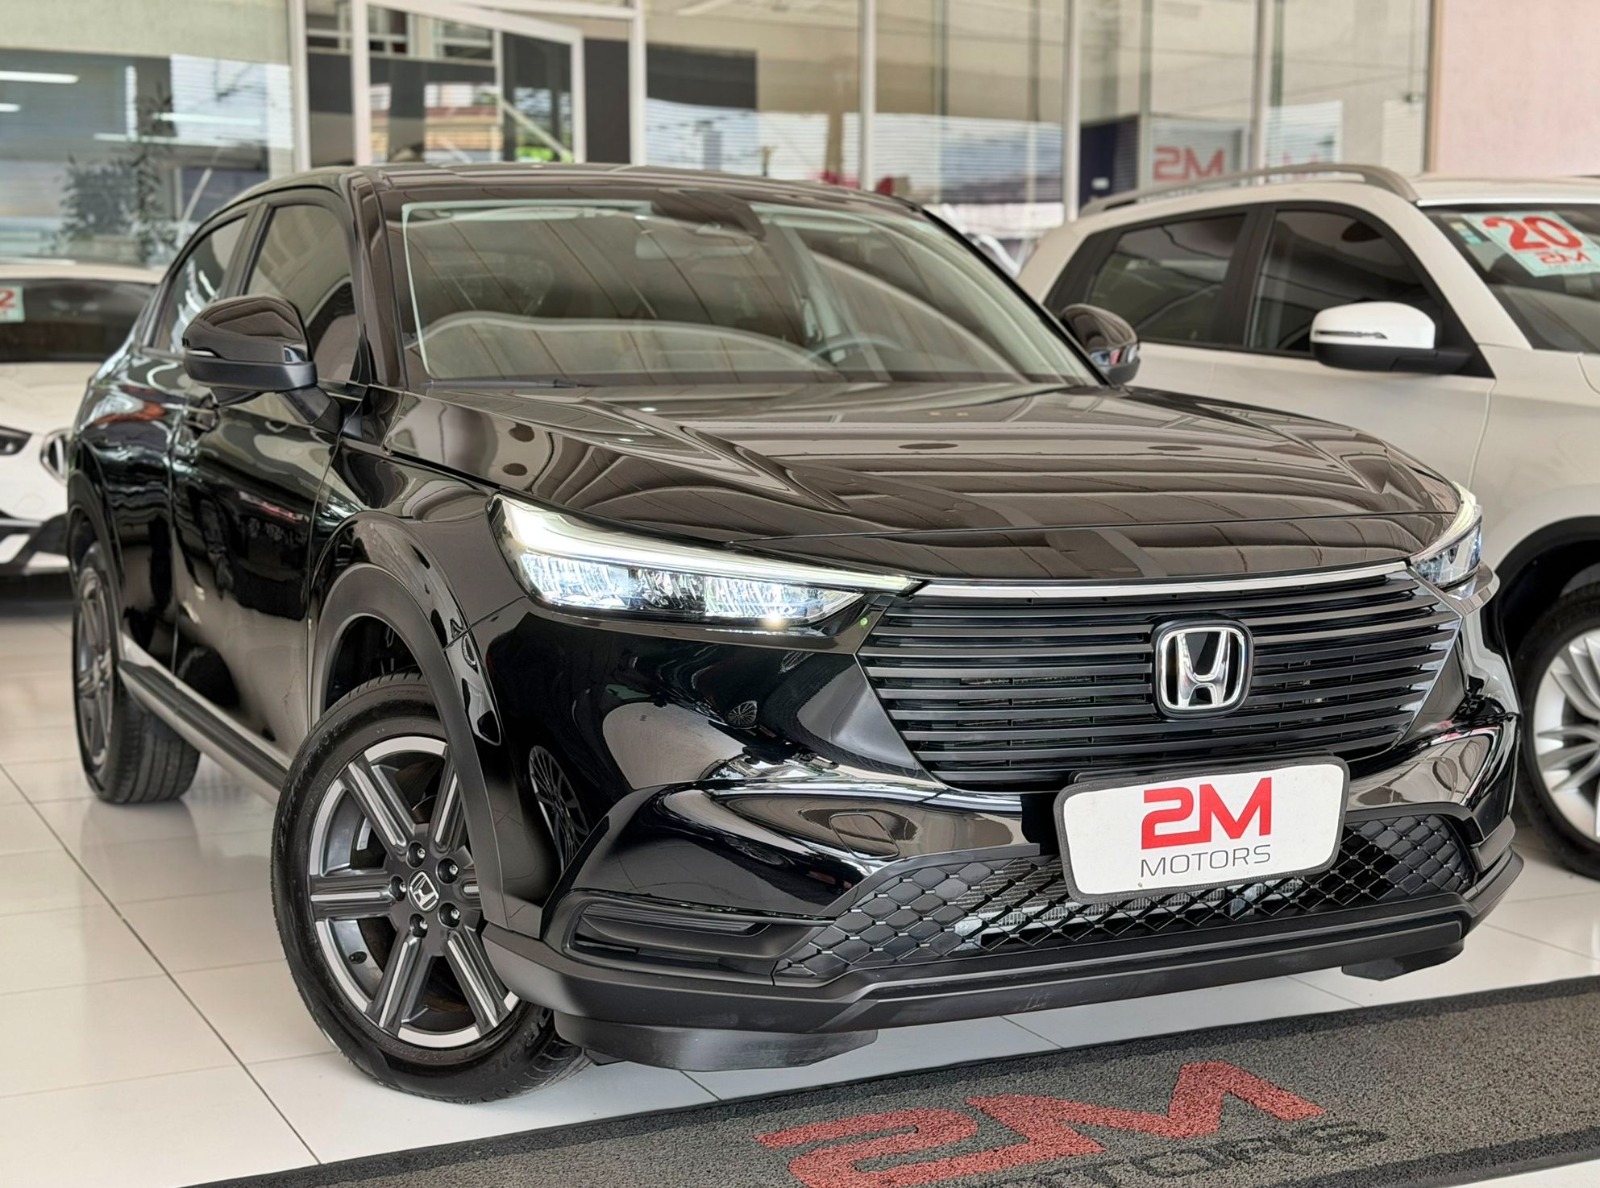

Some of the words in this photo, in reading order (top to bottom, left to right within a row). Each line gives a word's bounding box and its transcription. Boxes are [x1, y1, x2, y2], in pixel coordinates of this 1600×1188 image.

[1482, 215, 1582, 250] 20
[1141, 776, 1272, 850] 2M
[1140, 844, 1271, 878] MOTORS
[753, 1061, 1324, 1188] 2M
